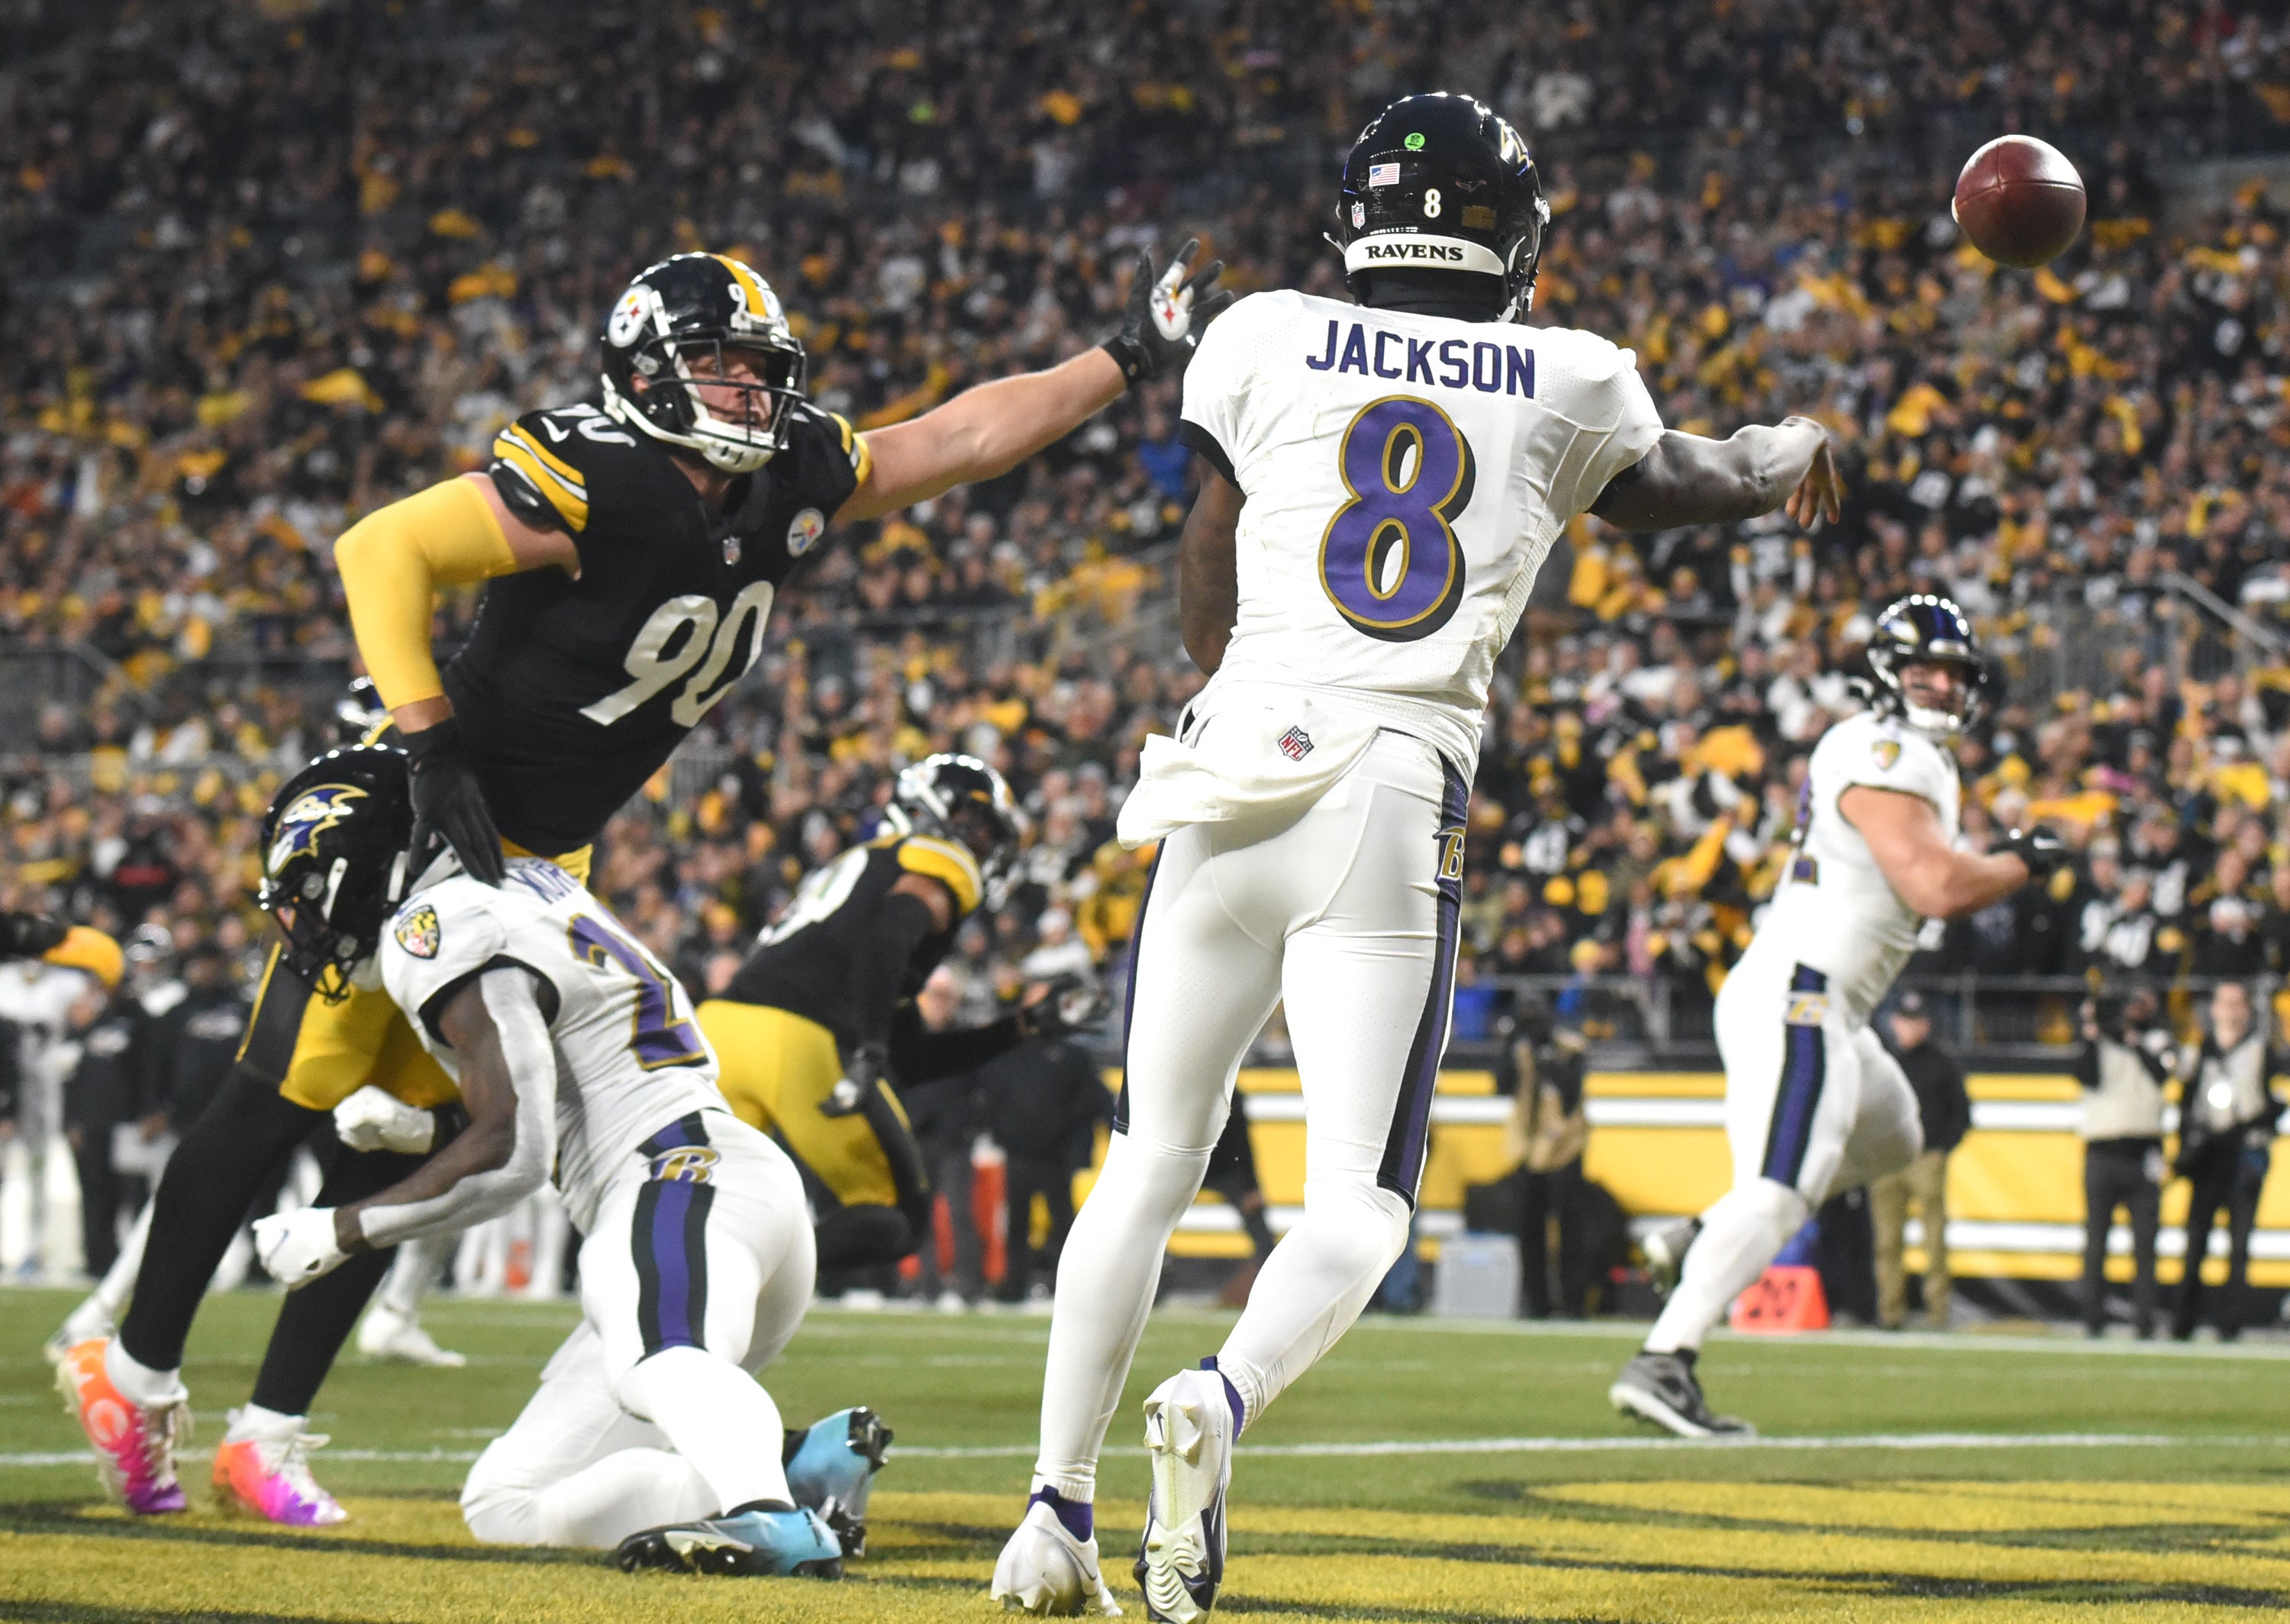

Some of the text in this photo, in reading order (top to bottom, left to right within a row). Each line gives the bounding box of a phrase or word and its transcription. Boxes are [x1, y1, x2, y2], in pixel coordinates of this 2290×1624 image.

[1424, 188, 1441, 218] 8
[1364, 243, 1464, 261] RAVENS
[1306, 320, 1534, 399] JACKSON
[1318, 395, 1476, 643] 8
[578, 580, 774, 728] 90
[1281, 735, 1304, 759] NFL
[567, 899, 710, 1072] 2
